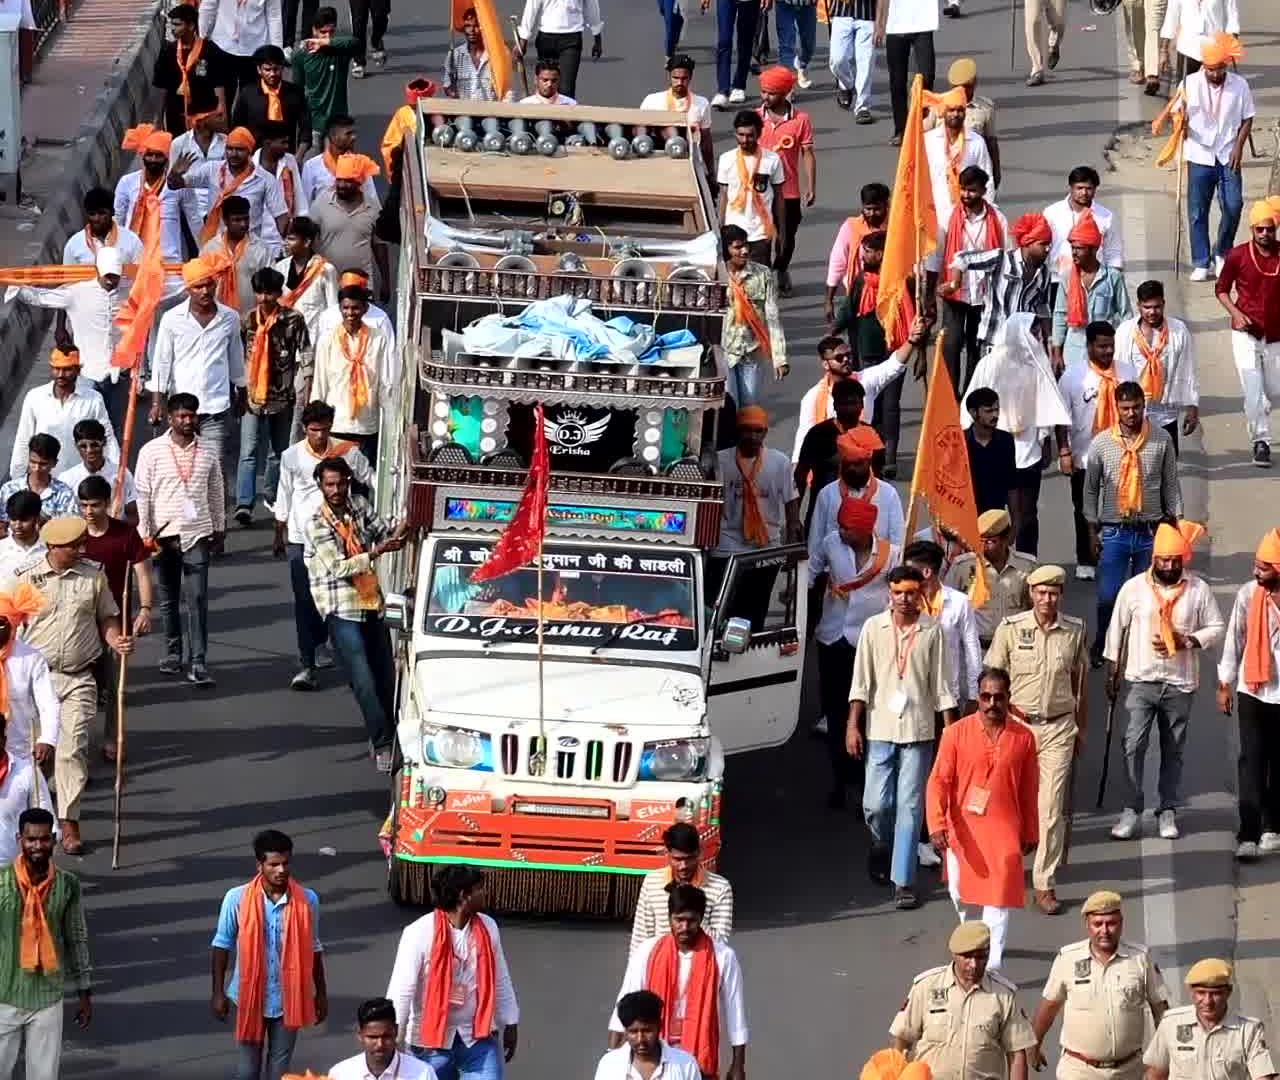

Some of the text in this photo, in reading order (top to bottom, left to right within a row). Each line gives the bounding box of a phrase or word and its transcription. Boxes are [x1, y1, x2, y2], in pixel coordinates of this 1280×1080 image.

[549, 445, 591, 456] Erisha
[443, 546, 463, 562] श्री
[588, 553, 607, 569] जी
[614, 553, 634, 571] की
[639, 557, 686, 573] लाडली
[611, 622, 678, 645] Raj
